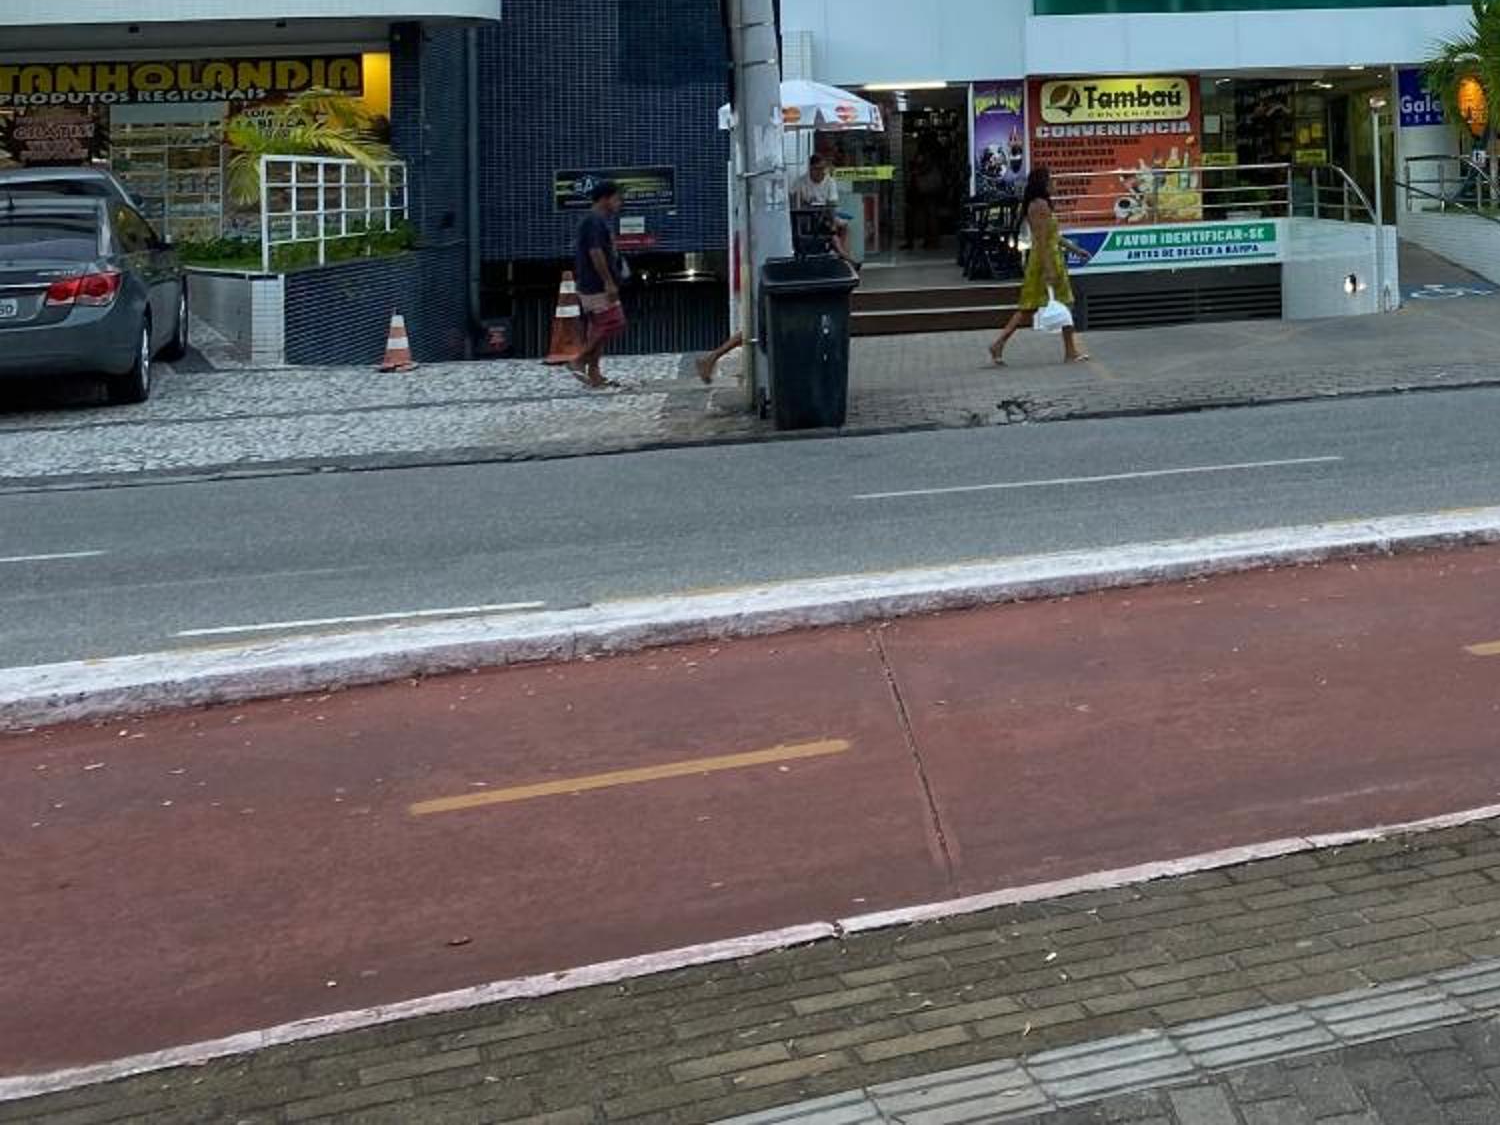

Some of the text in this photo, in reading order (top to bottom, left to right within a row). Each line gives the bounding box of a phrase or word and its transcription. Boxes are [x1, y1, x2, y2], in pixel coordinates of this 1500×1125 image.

[0, 88, 267, 105] PRODUTOS REGIONAIS
[1083, 82, 1182, 109] Tambaú
[1115, 228, 1265, 246] FAVOR IDENTIFICAR-SE
[1127, 250, 1159, 260] ANTES
[1161, 249, 1174, 258] DE
[1177, 247, 1213, 257] DESCER
[1225, 244, 1260, 254] RAMPA
